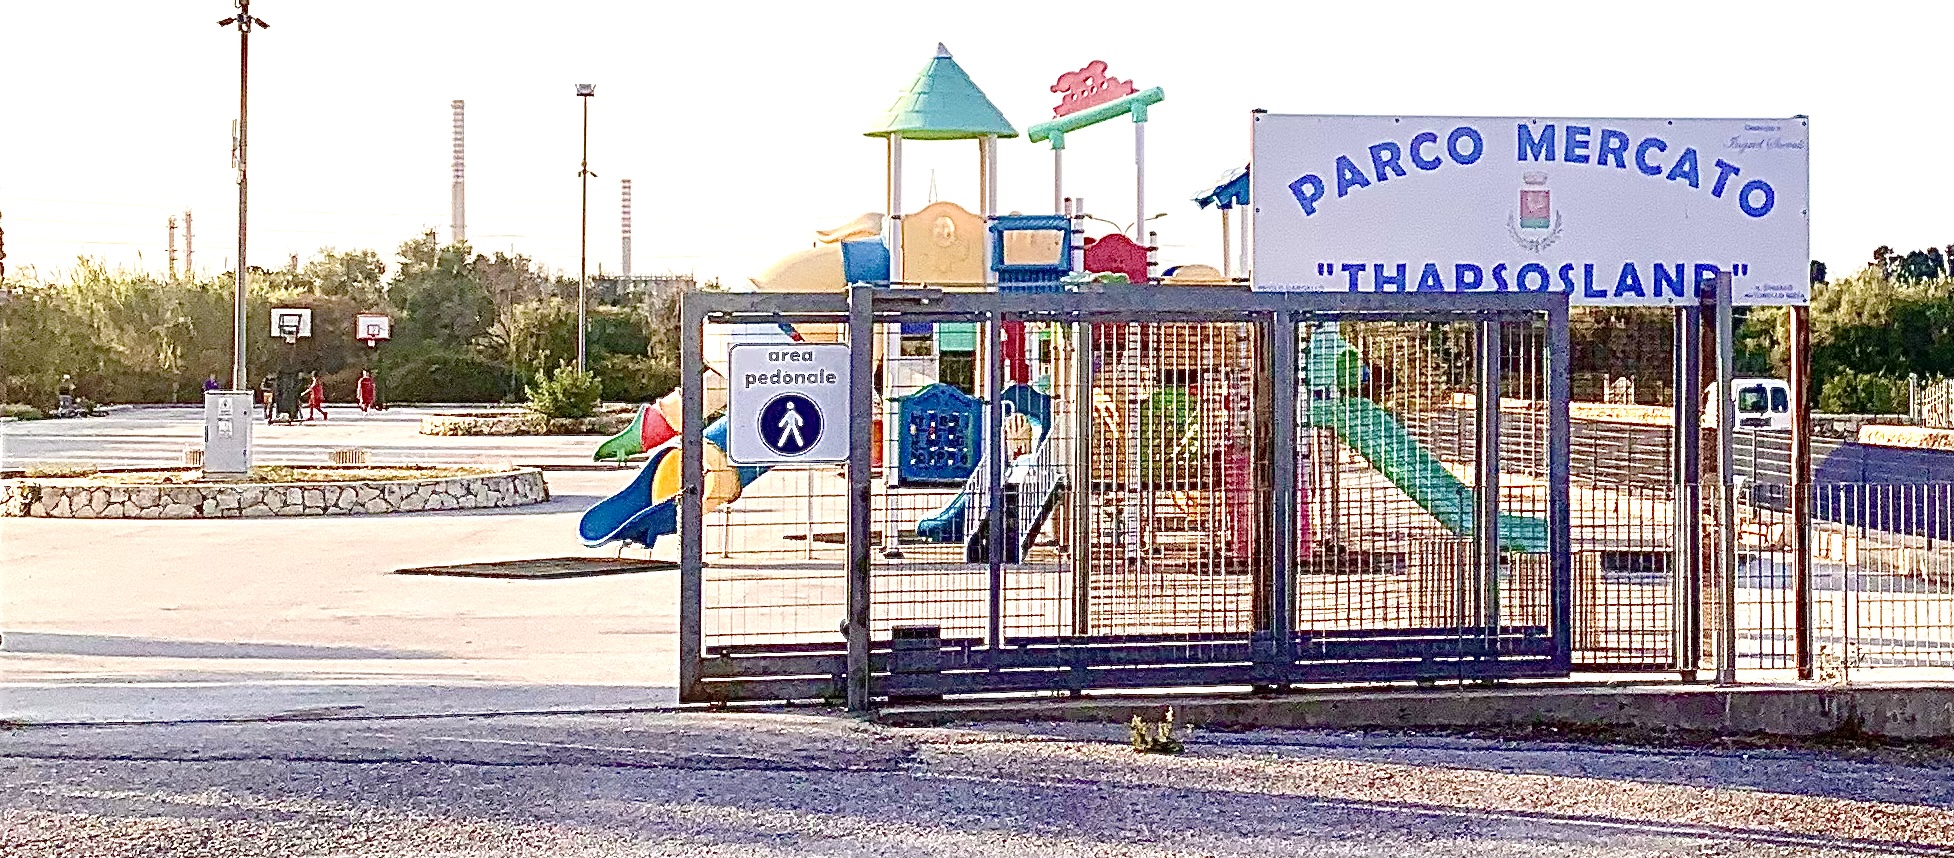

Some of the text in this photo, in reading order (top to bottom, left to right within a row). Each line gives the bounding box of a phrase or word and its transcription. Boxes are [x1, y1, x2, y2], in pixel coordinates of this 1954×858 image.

[1288, 123, 1775, 218] PARCO MERCATO
[768, 350, 813, 362] area
[744, 368, 837, 389] pedonale
